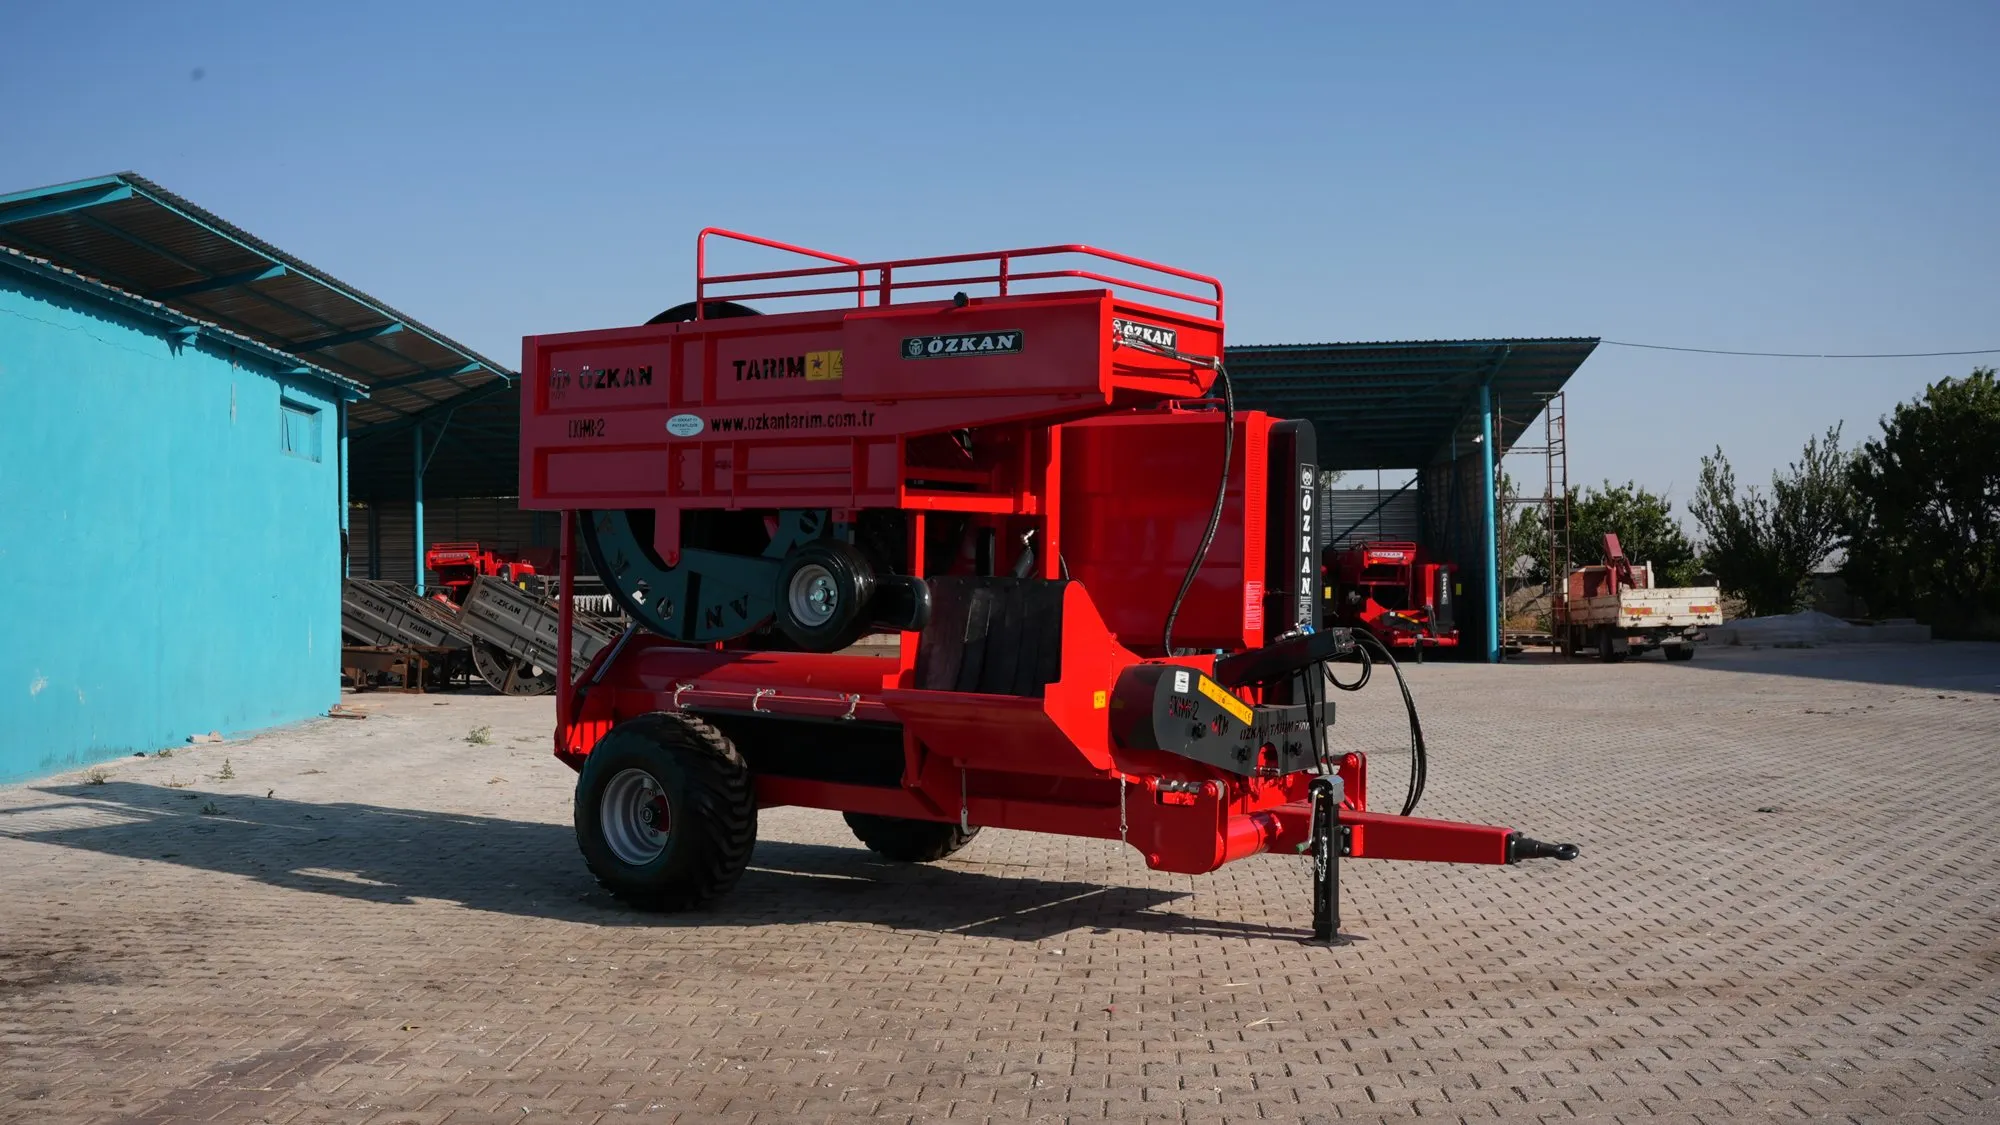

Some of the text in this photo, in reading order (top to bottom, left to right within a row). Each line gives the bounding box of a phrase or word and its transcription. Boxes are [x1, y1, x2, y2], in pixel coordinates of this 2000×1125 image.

[927, 335, 1016, 354] ÖZKAN
[1123, 321, 1173, 346] ÖZKAN
[578, 355, 805, 389] ÖZKAN TARIM
[710, 409, 875, 433] www.ozkantarim.com.tr
[1300, 489, 1312, 595] ÖZKAN
